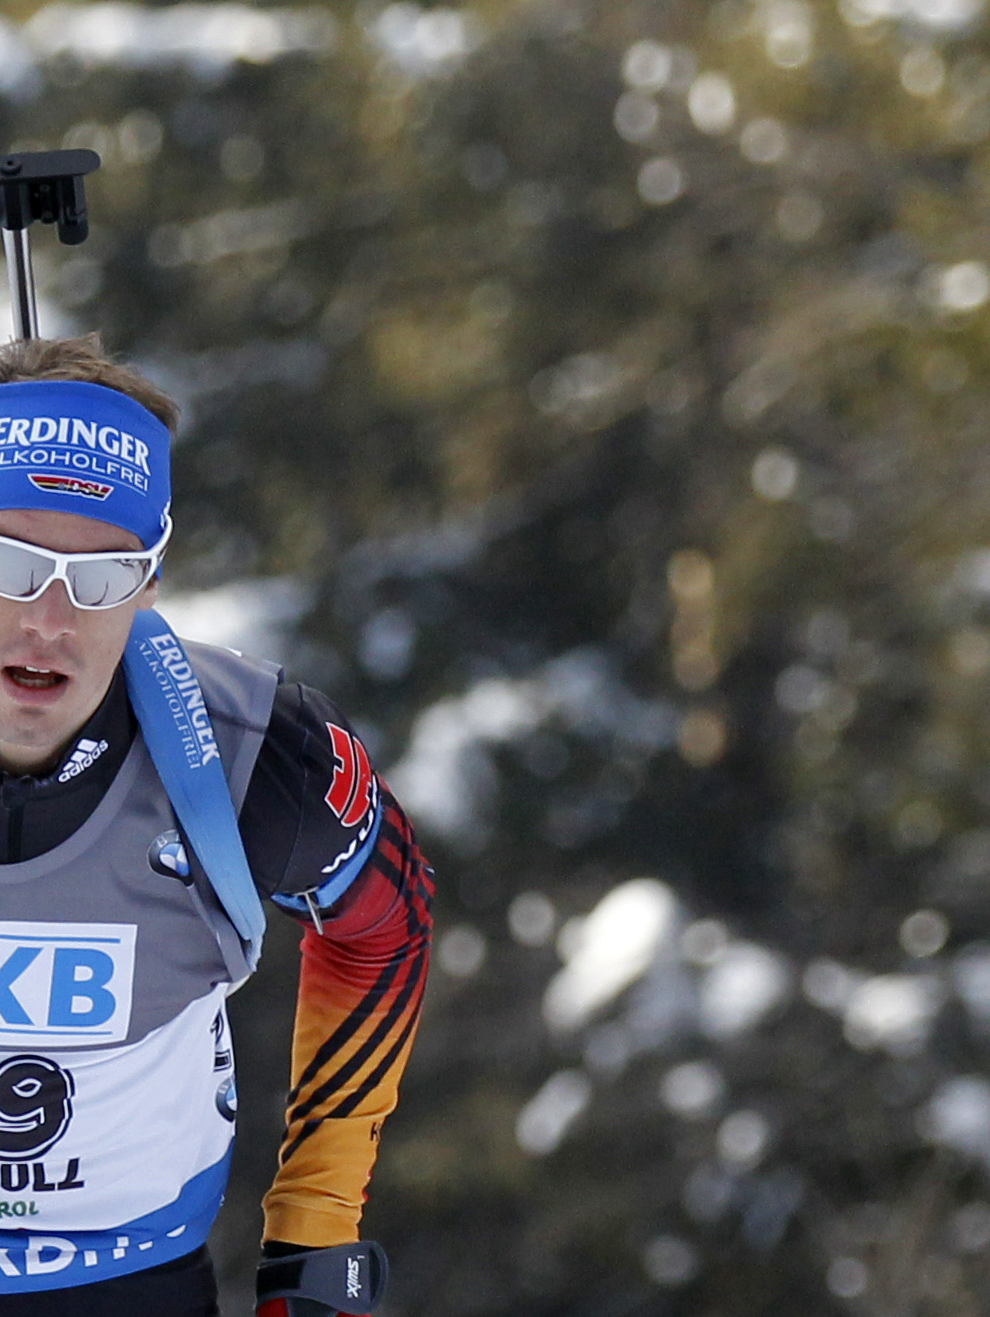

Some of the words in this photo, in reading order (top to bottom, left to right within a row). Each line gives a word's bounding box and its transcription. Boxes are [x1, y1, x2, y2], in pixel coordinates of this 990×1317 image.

[58, 739, 109, 783] adidas
[136, 638, 201, 770] ALKOHOLFREI
[149, 633, 221, 766] ERDINGER
